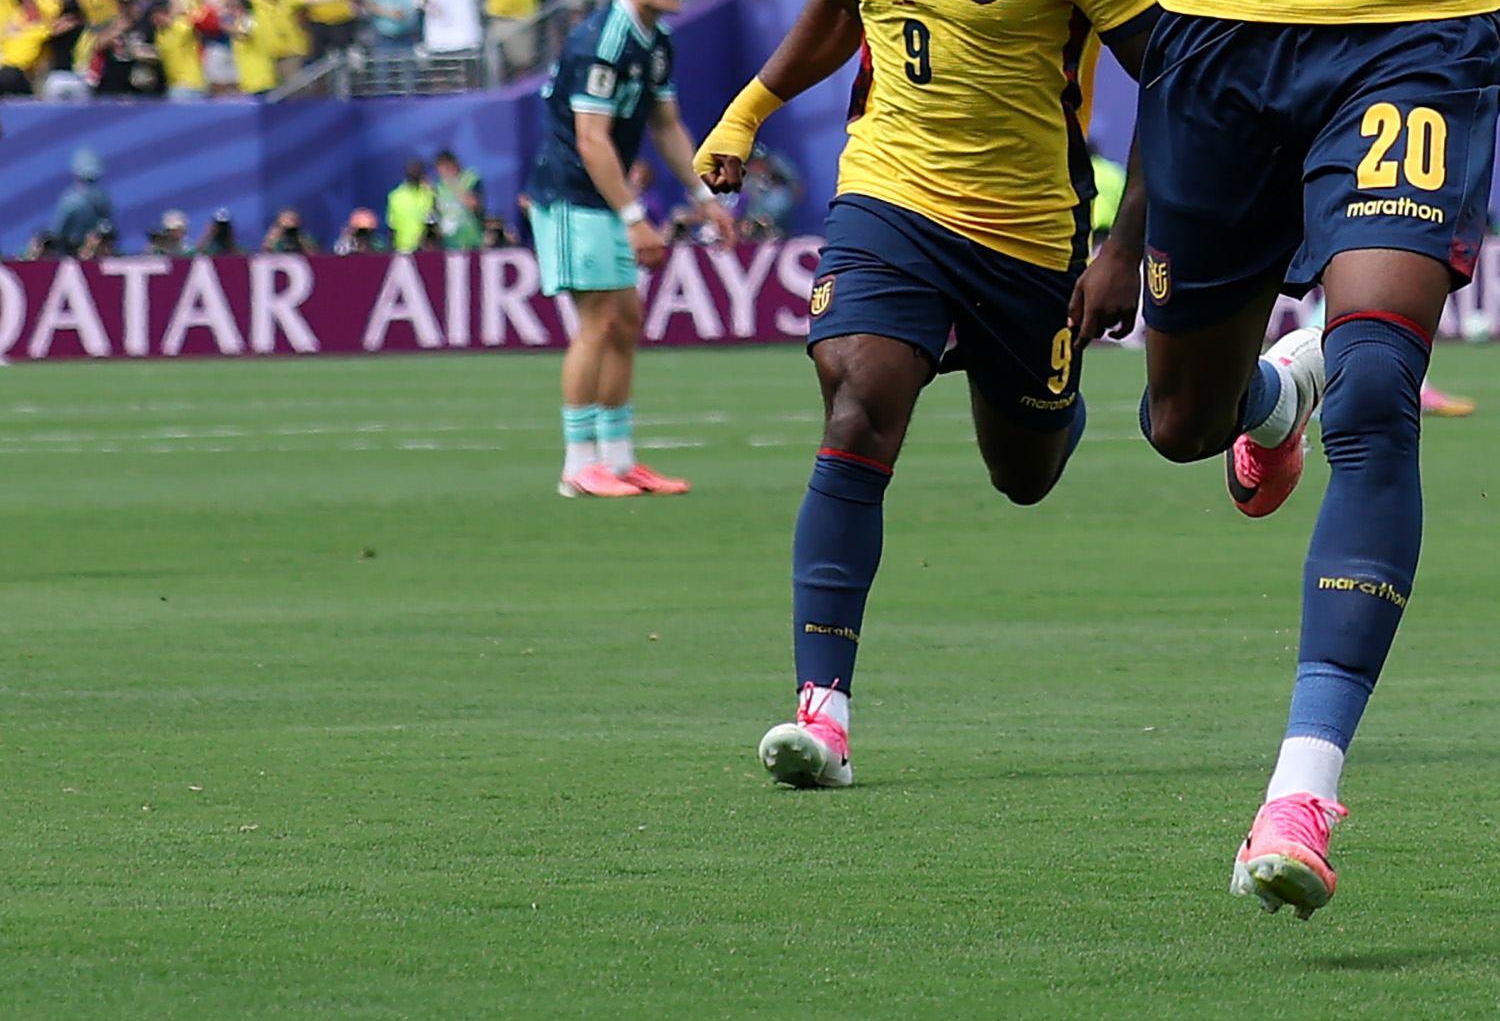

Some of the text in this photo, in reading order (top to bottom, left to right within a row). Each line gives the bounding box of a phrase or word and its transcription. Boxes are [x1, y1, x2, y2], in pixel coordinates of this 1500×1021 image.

[903, 19, 932, 85] 9
[1357, 102, 1447, 191] 20
[1346, 197, 1444, 224] marathon
[362, 236, 826, 352] AIRAYS
[1047, 327, 1072, 395] 9
[1318, 577, 1406, 609] marathon
